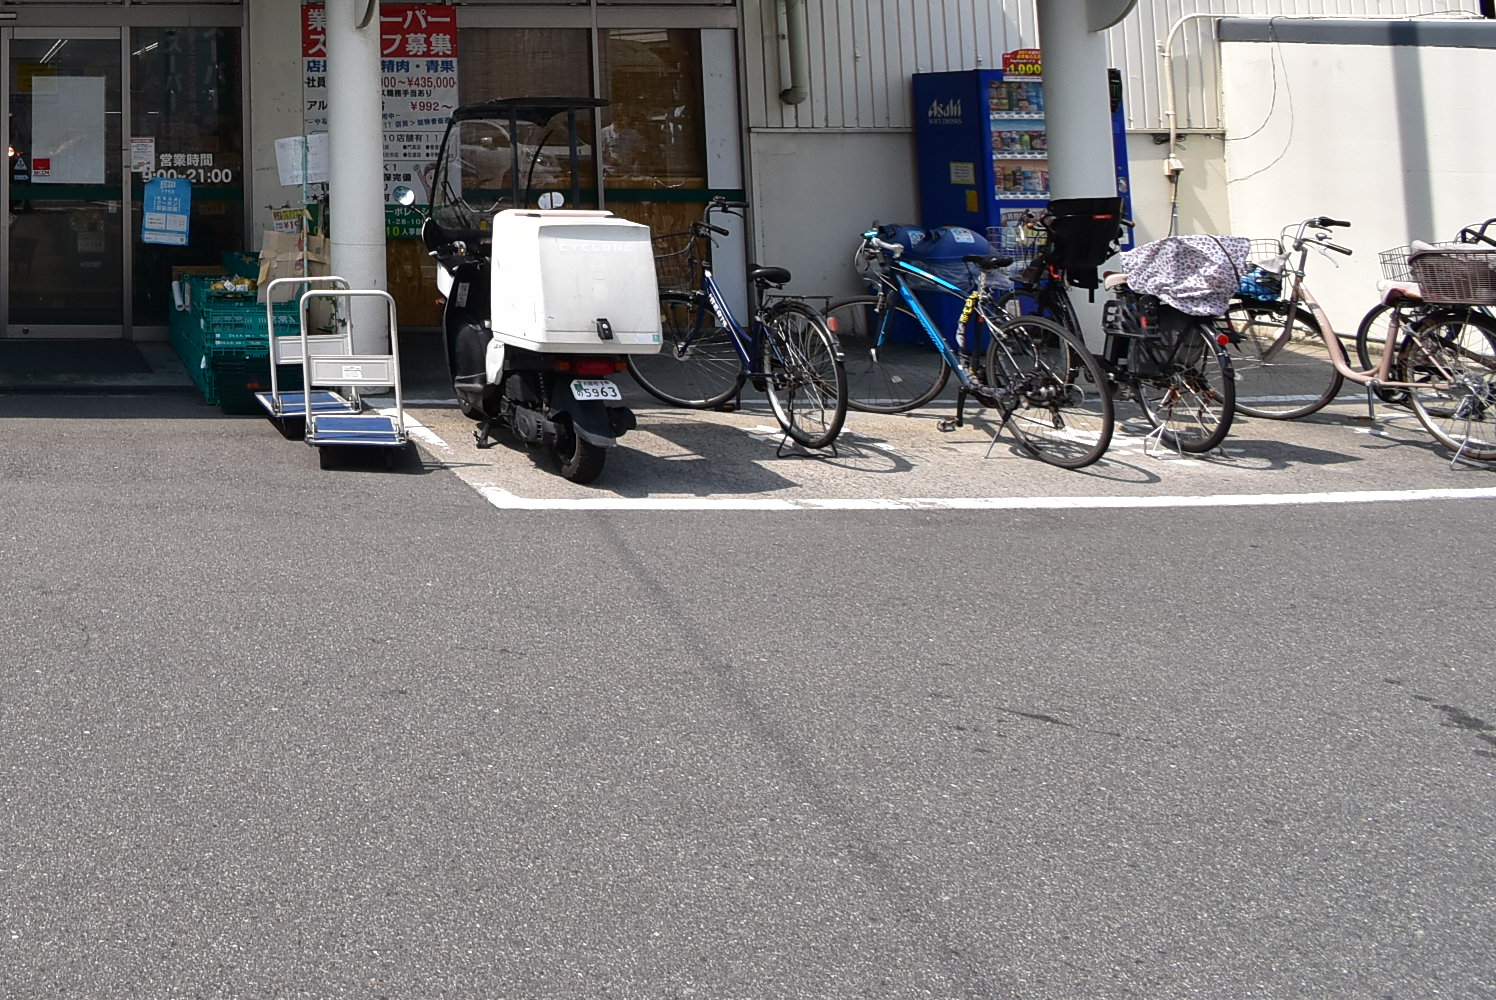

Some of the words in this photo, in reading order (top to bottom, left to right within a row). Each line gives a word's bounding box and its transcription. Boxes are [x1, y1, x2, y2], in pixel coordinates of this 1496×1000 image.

[307, 77, 327, 88] 社員
[928, 98, 961, 117] Asahi
[160, 153, 213, 167] 営業時間
[584, 386, 617, 397] 5963
